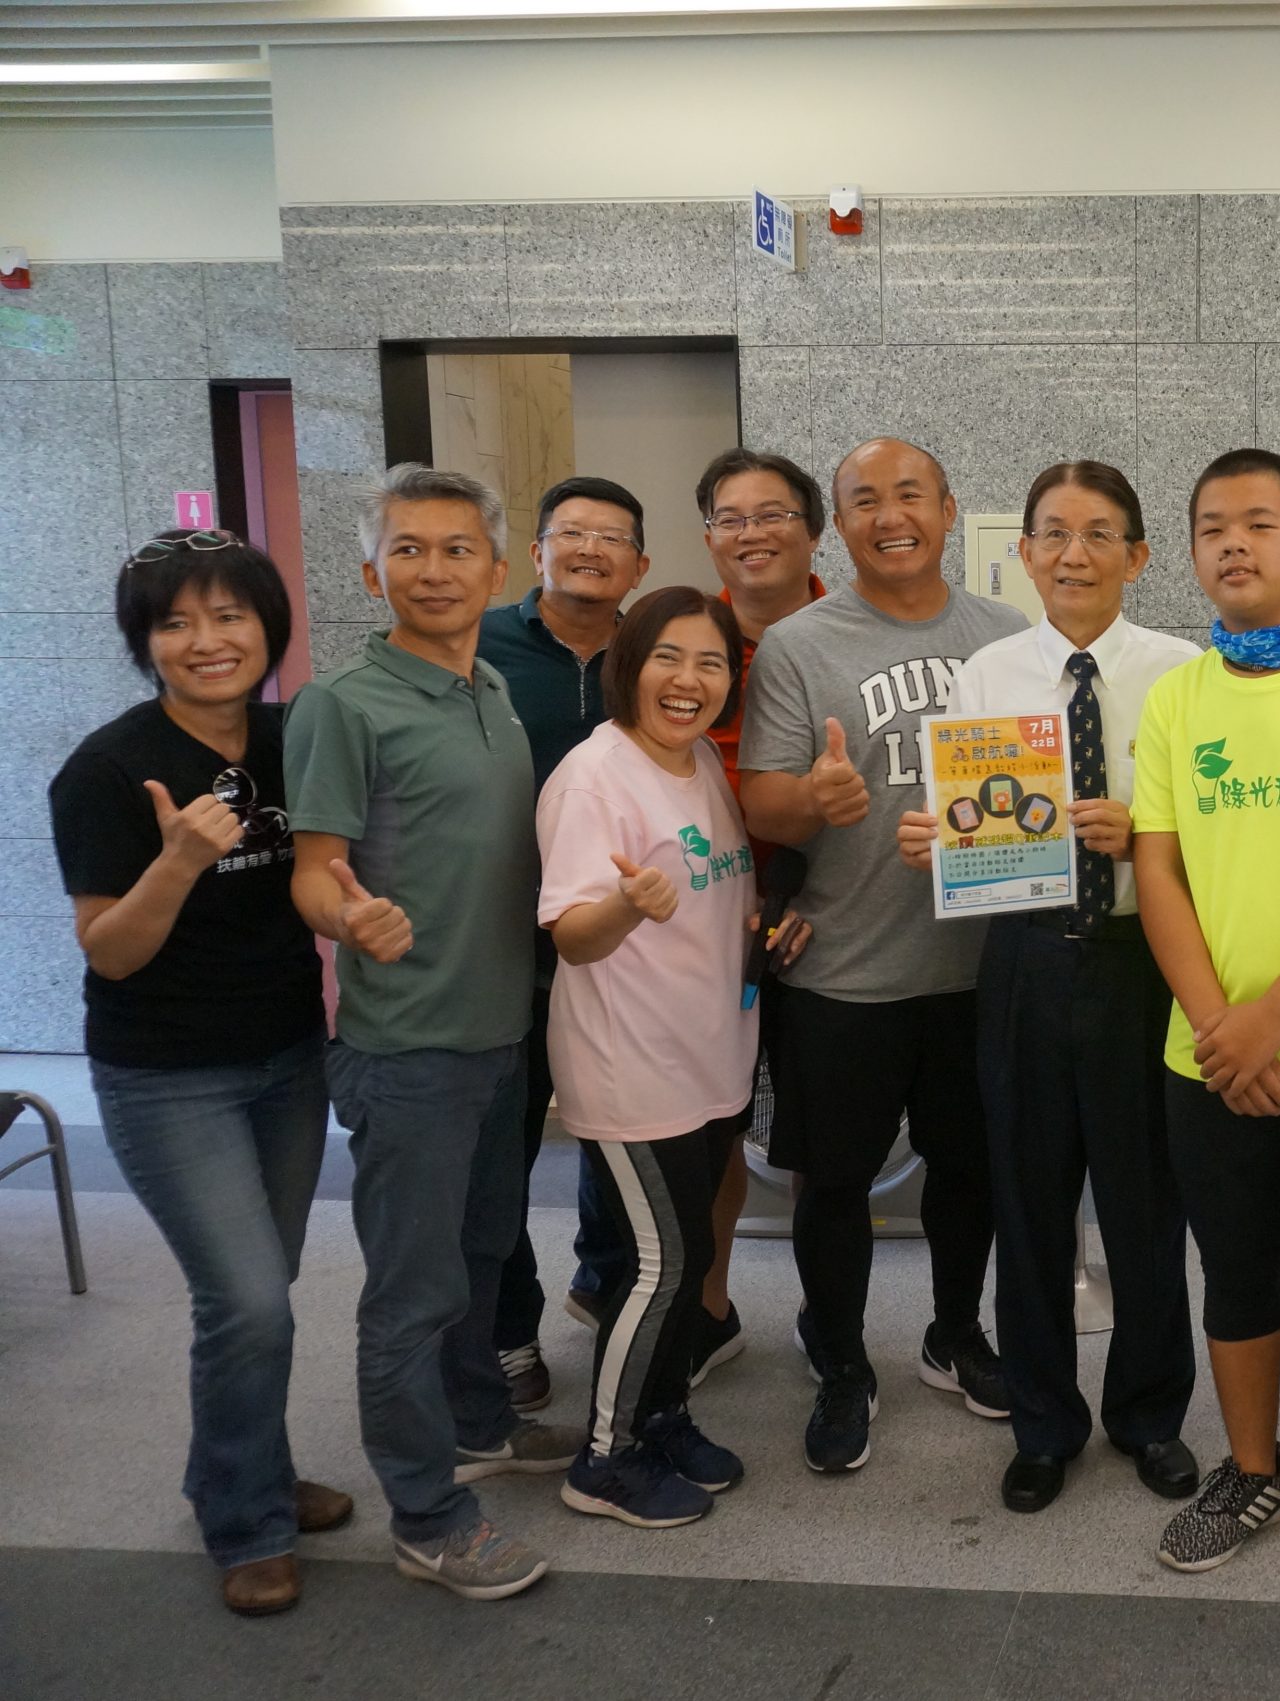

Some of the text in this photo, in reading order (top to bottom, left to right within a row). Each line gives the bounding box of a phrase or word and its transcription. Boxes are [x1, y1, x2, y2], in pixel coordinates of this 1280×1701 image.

[774, 205, 792, 231] 無障礙
[1029, 719, 1054, 735] 7月
[1031, 737, 1056, 749] 22日
